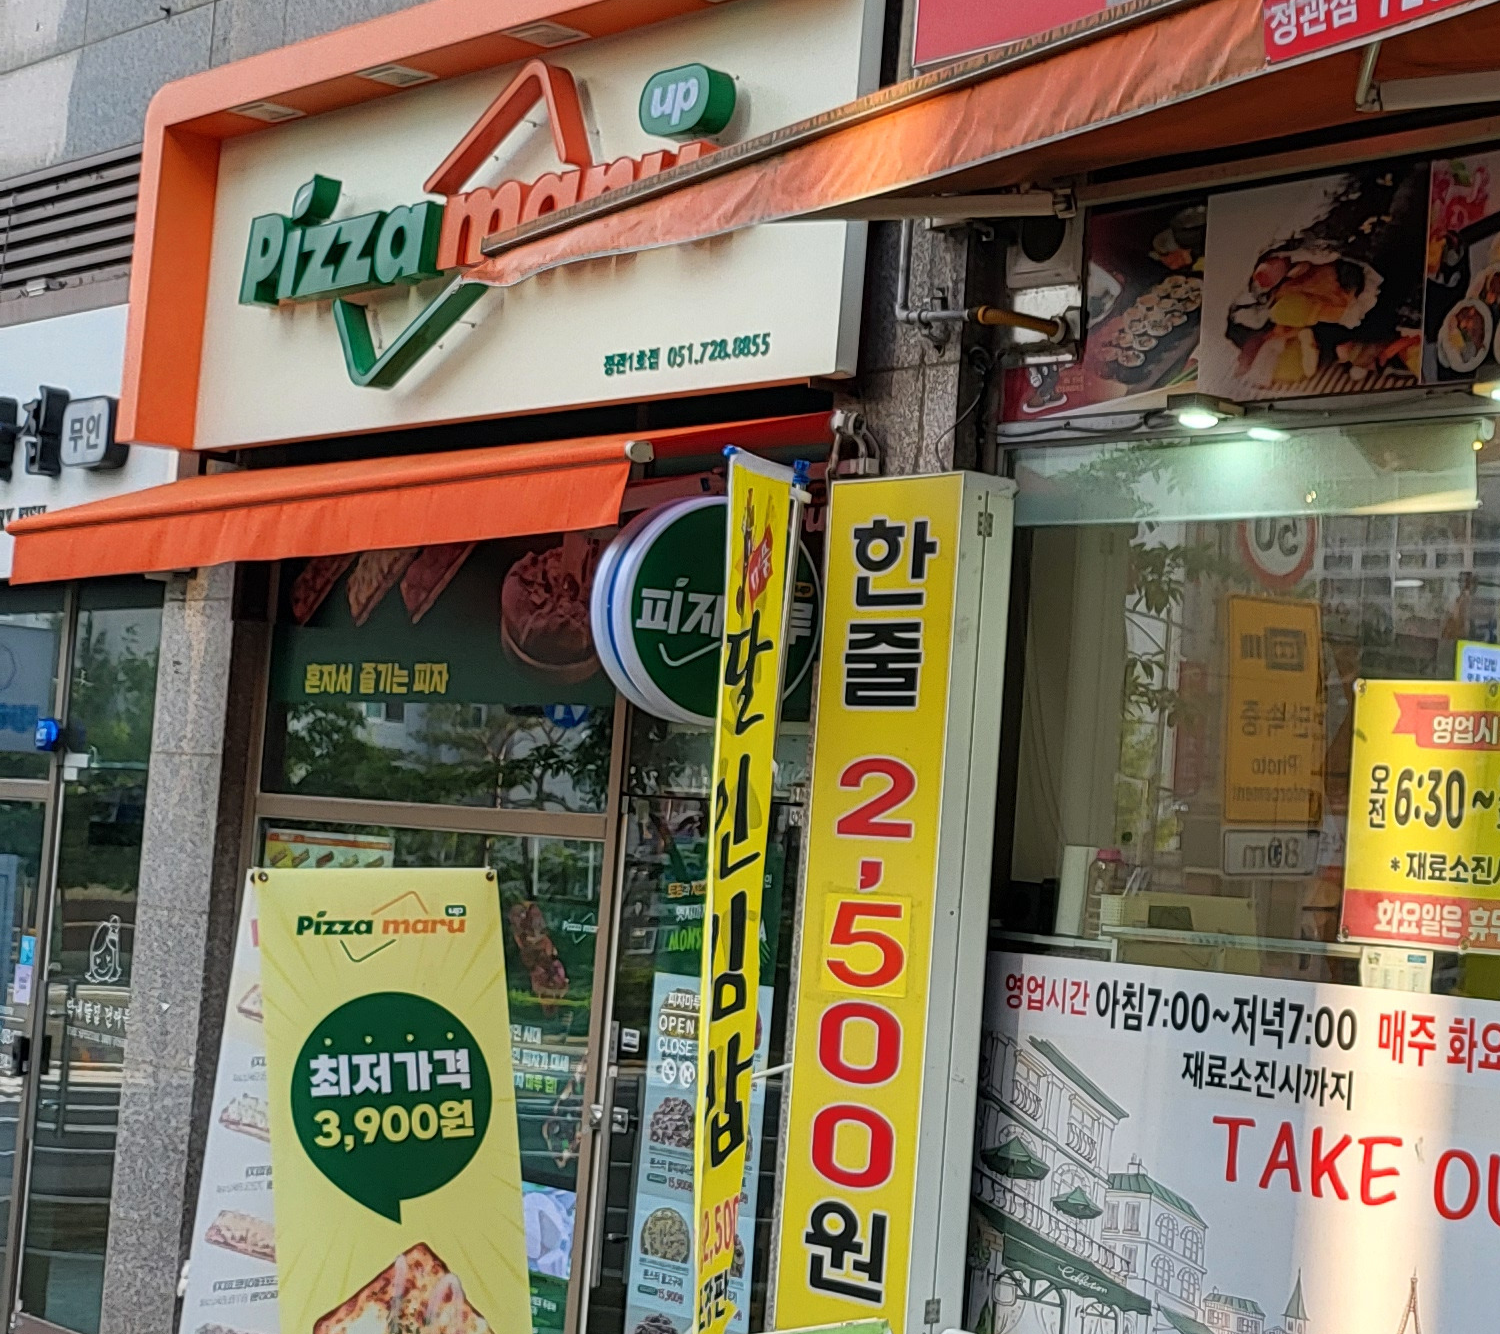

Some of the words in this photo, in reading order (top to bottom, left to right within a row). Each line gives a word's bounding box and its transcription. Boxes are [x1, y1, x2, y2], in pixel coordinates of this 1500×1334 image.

[648, 73, 699, 121] up
[240, 174, 444, 307] Pizza
[69, 413, 102, 454] 무인
[636, 578, 814, 645] 피자루
[843, 516, 940, 712] 한줄
[305, 663, 353, 695] 혼자서
[359, 662, 408, 694] 즐기는
[413, 662, 449, 694] 피자
[1393, 768, 1466, 830] 6:30
[296, 910, 374, 937] Pizza
[381, 914, 468, 936] maru
[1374, 898, 1463, 941] 화요일은
[658, 1014, 696, 1035] OPEN
[1003, 972, 1091, 1017] 영업시간
[1377, 1008, 1439, 1068] 매주
[308, 1046, 473, 1099] 최저가격
[657, 1038, 693, 1057] CLOSE
[1180, 1050, 1356, 1111] 재료소진시까지
[312, 1098, 477, 1153] 3,900원
[1211, 1115, 1405, 1207] TAKE
